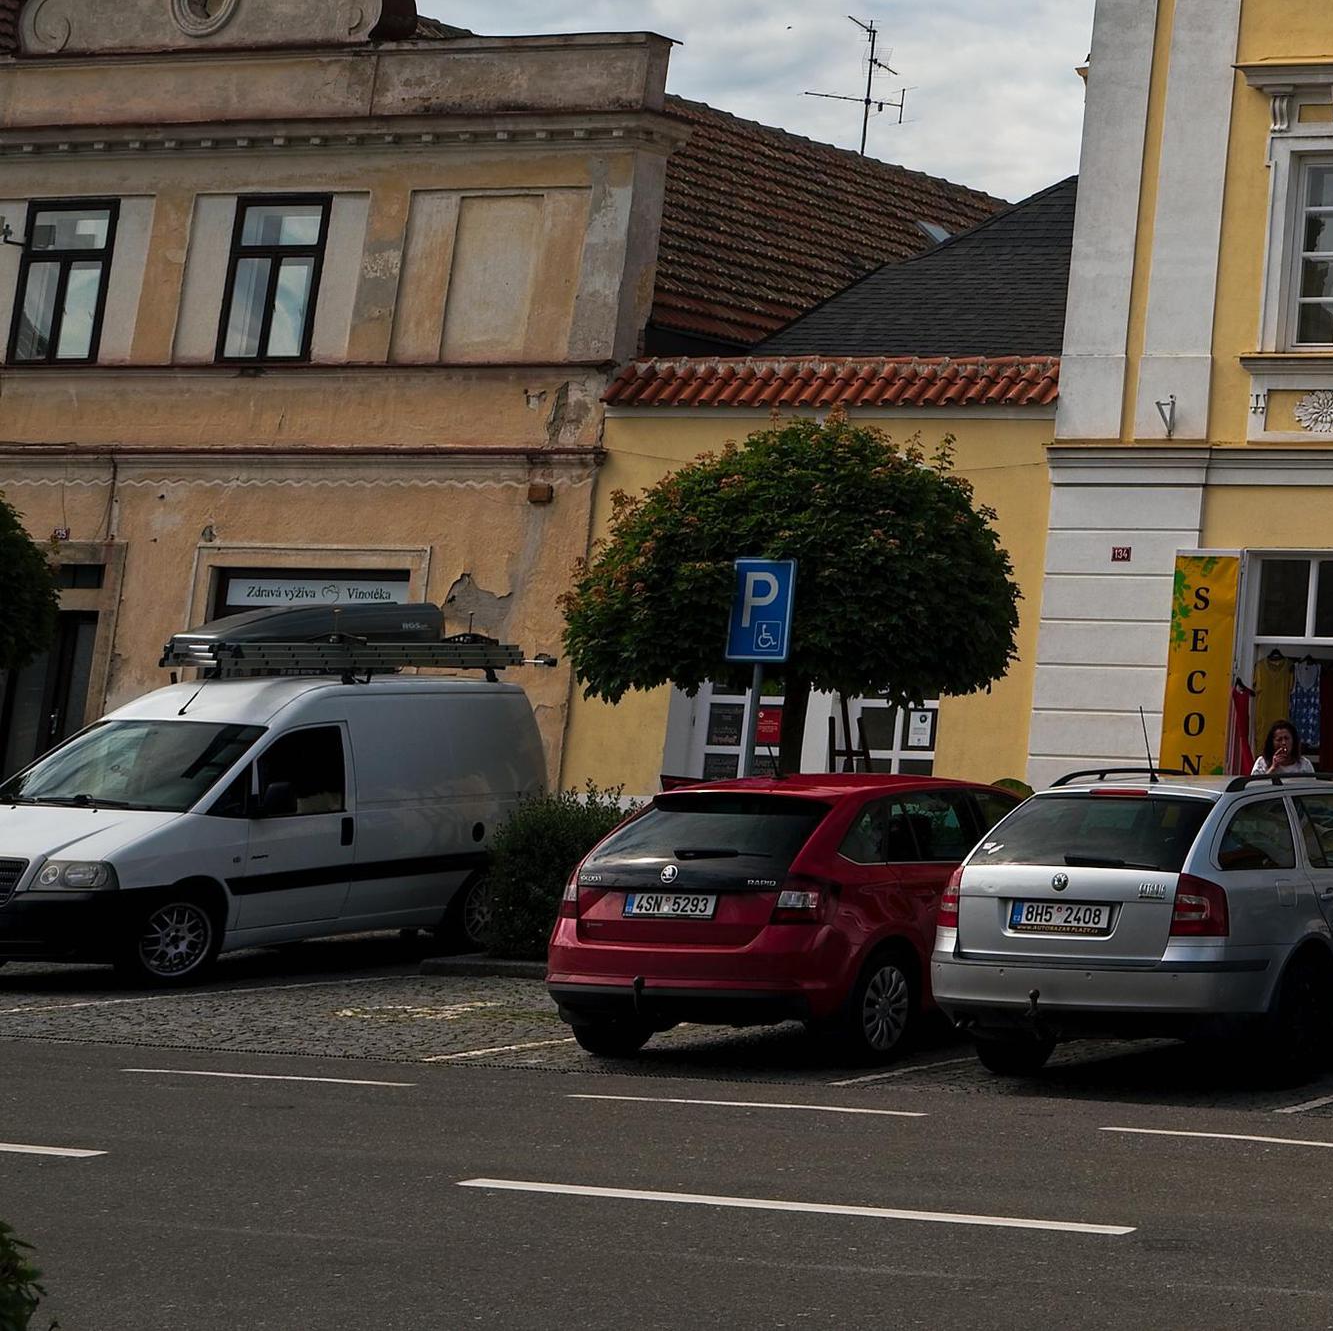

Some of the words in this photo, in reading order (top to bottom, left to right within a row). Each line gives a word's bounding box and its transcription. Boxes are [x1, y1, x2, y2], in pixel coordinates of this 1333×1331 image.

[1115, 549, 1128, 559] 134
[246, 586, 281, 598] Zdravá
[284, 586, 316, 601] výživa
[347, 588, 391, 600] Vinotéka
[741, 571, 779, 628] P
[1180, 587, 1210, 775] SECON
[747, 879, 777, 887] RAPID
[635, 895, 663, 913] 4SN
[672, 896, 710, 913] 5293
[1025, 904, 1054, 922] 8H5
[1063, 906, 1102, 925] 2408
